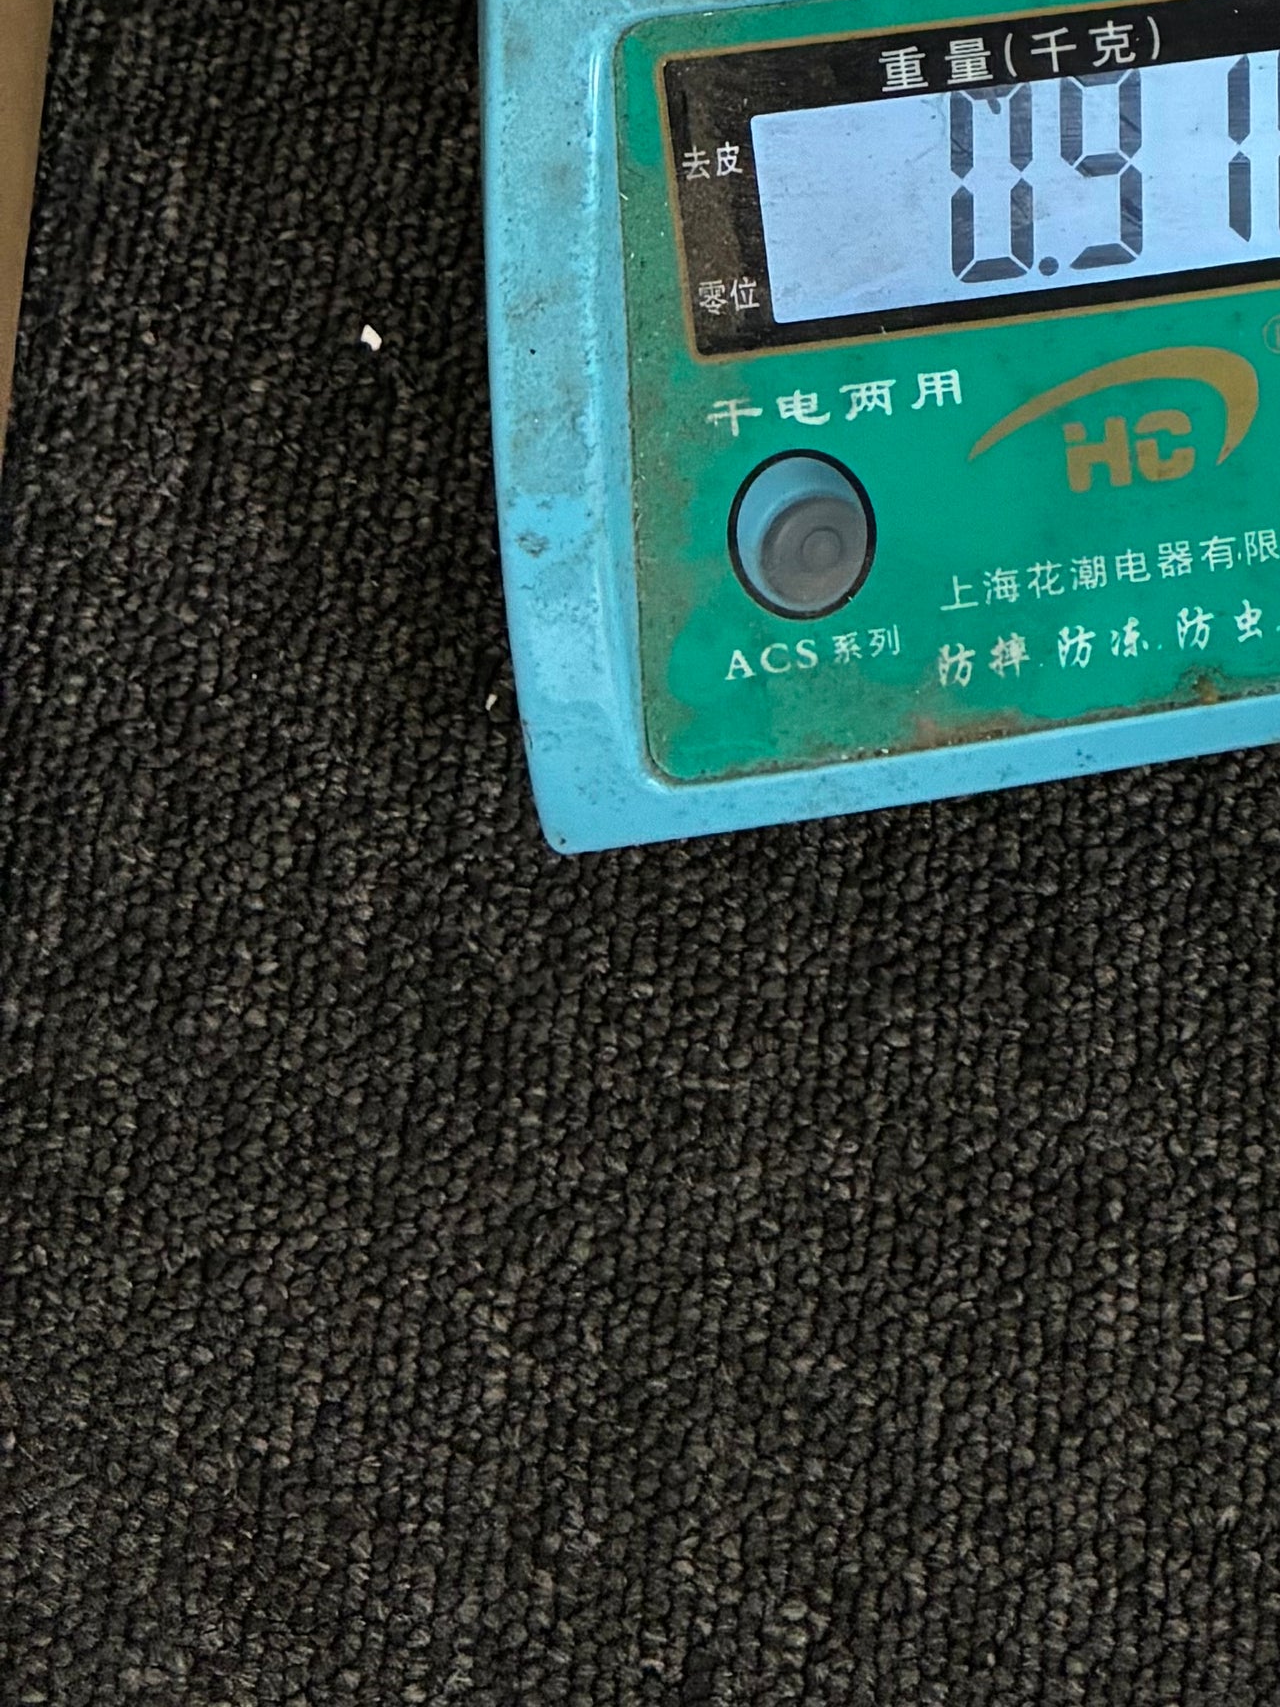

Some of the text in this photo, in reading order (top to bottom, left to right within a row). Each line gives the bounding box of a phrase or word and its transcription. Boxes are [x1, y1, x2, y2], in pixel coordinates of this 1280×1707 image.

[877, 16, 1163, 94] 重量(千克)
[681, 140, 745, 182] 去皮
[697, 277, 760, 313] 零位
[1064, 409, 1196, 493] HC
[724, 623, 901, 681] ACS 系列
